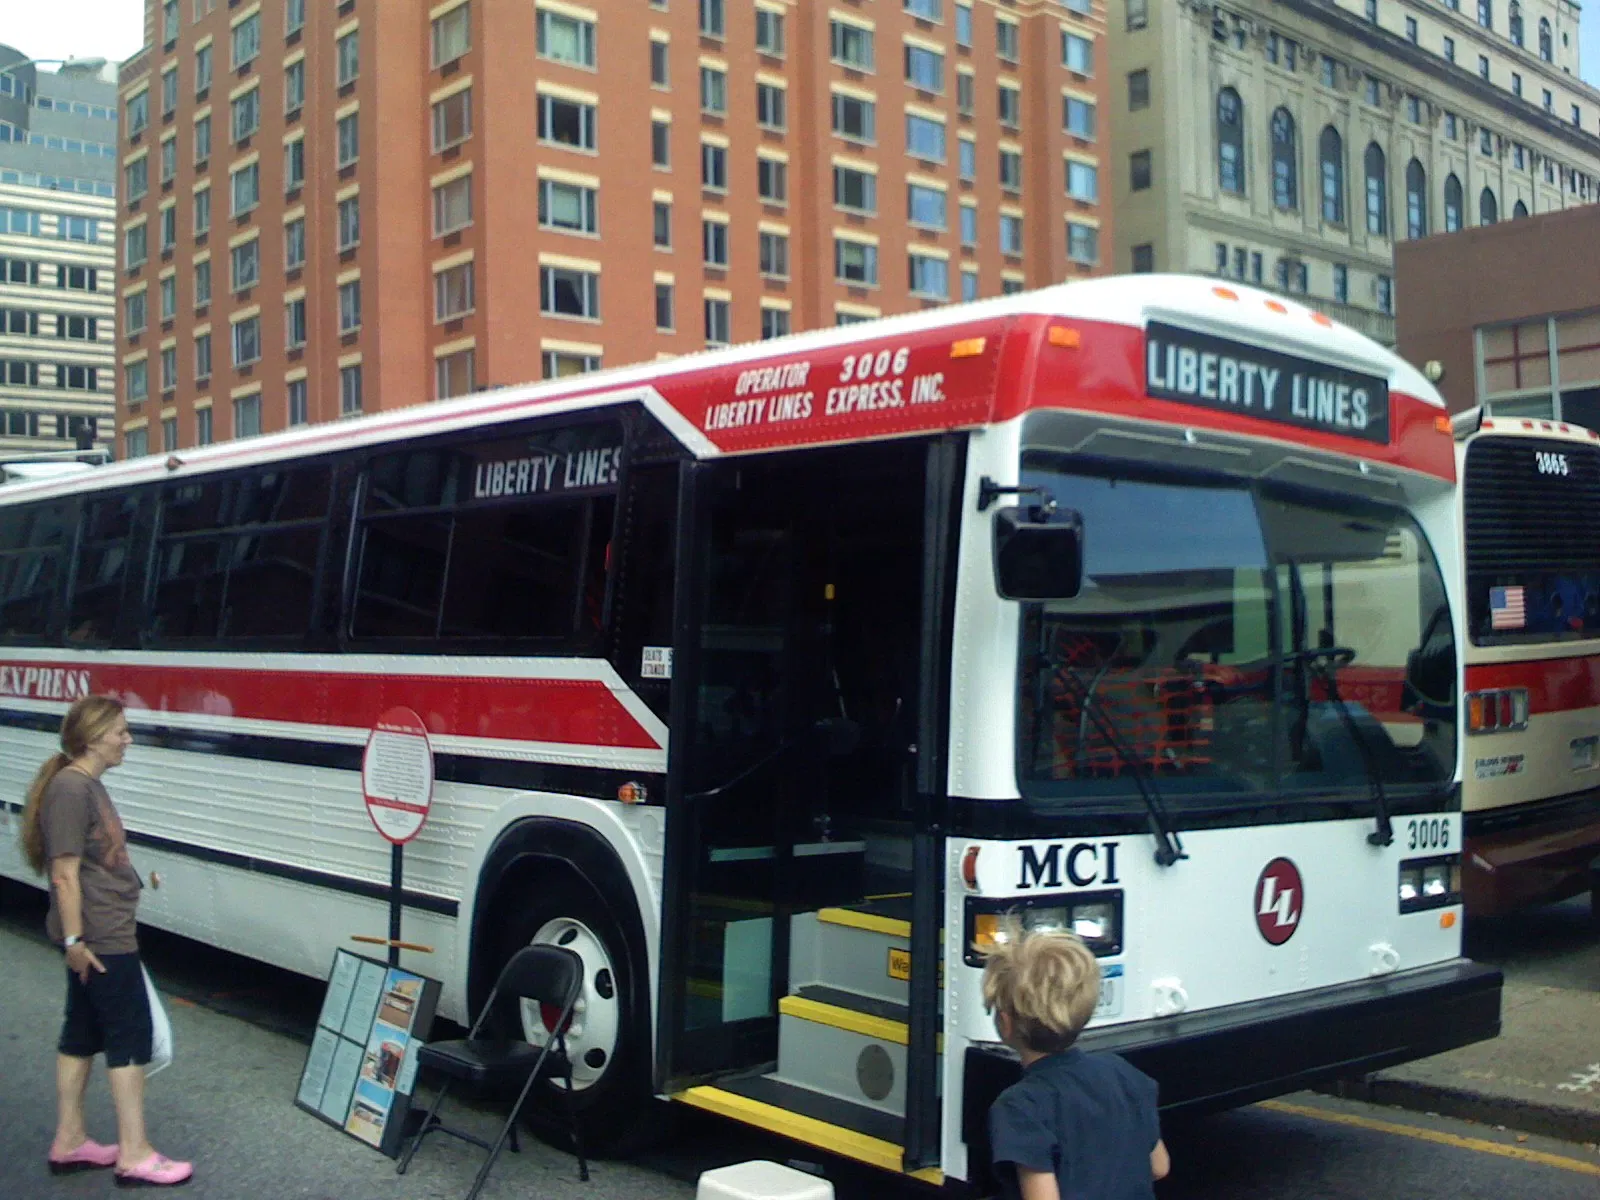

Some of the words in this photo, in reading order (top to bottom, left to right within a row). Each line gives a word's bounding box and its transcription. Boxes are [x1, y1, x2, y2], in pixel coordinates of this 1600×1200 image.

[735, 361, 811, 396] OPERATOR
[839, 347, 910, 382] 3006
[1148, 340, 1280, 411] LIBERTY
[1291, 373, 1369, 430] LINES
[704, 397, 767, 431] LIBERTY
[768, 391, 814, 423] LINES
[910, 372, 946, 404] INC.
[474, 454, 558, 498] LIBERTY
[564, 446, 622, 488] LINES
[0, 665, 91, 700] EXPRESS
[1408, 818, 1451, 850] 3006
[1016, 842, 1120, 889] MCI
